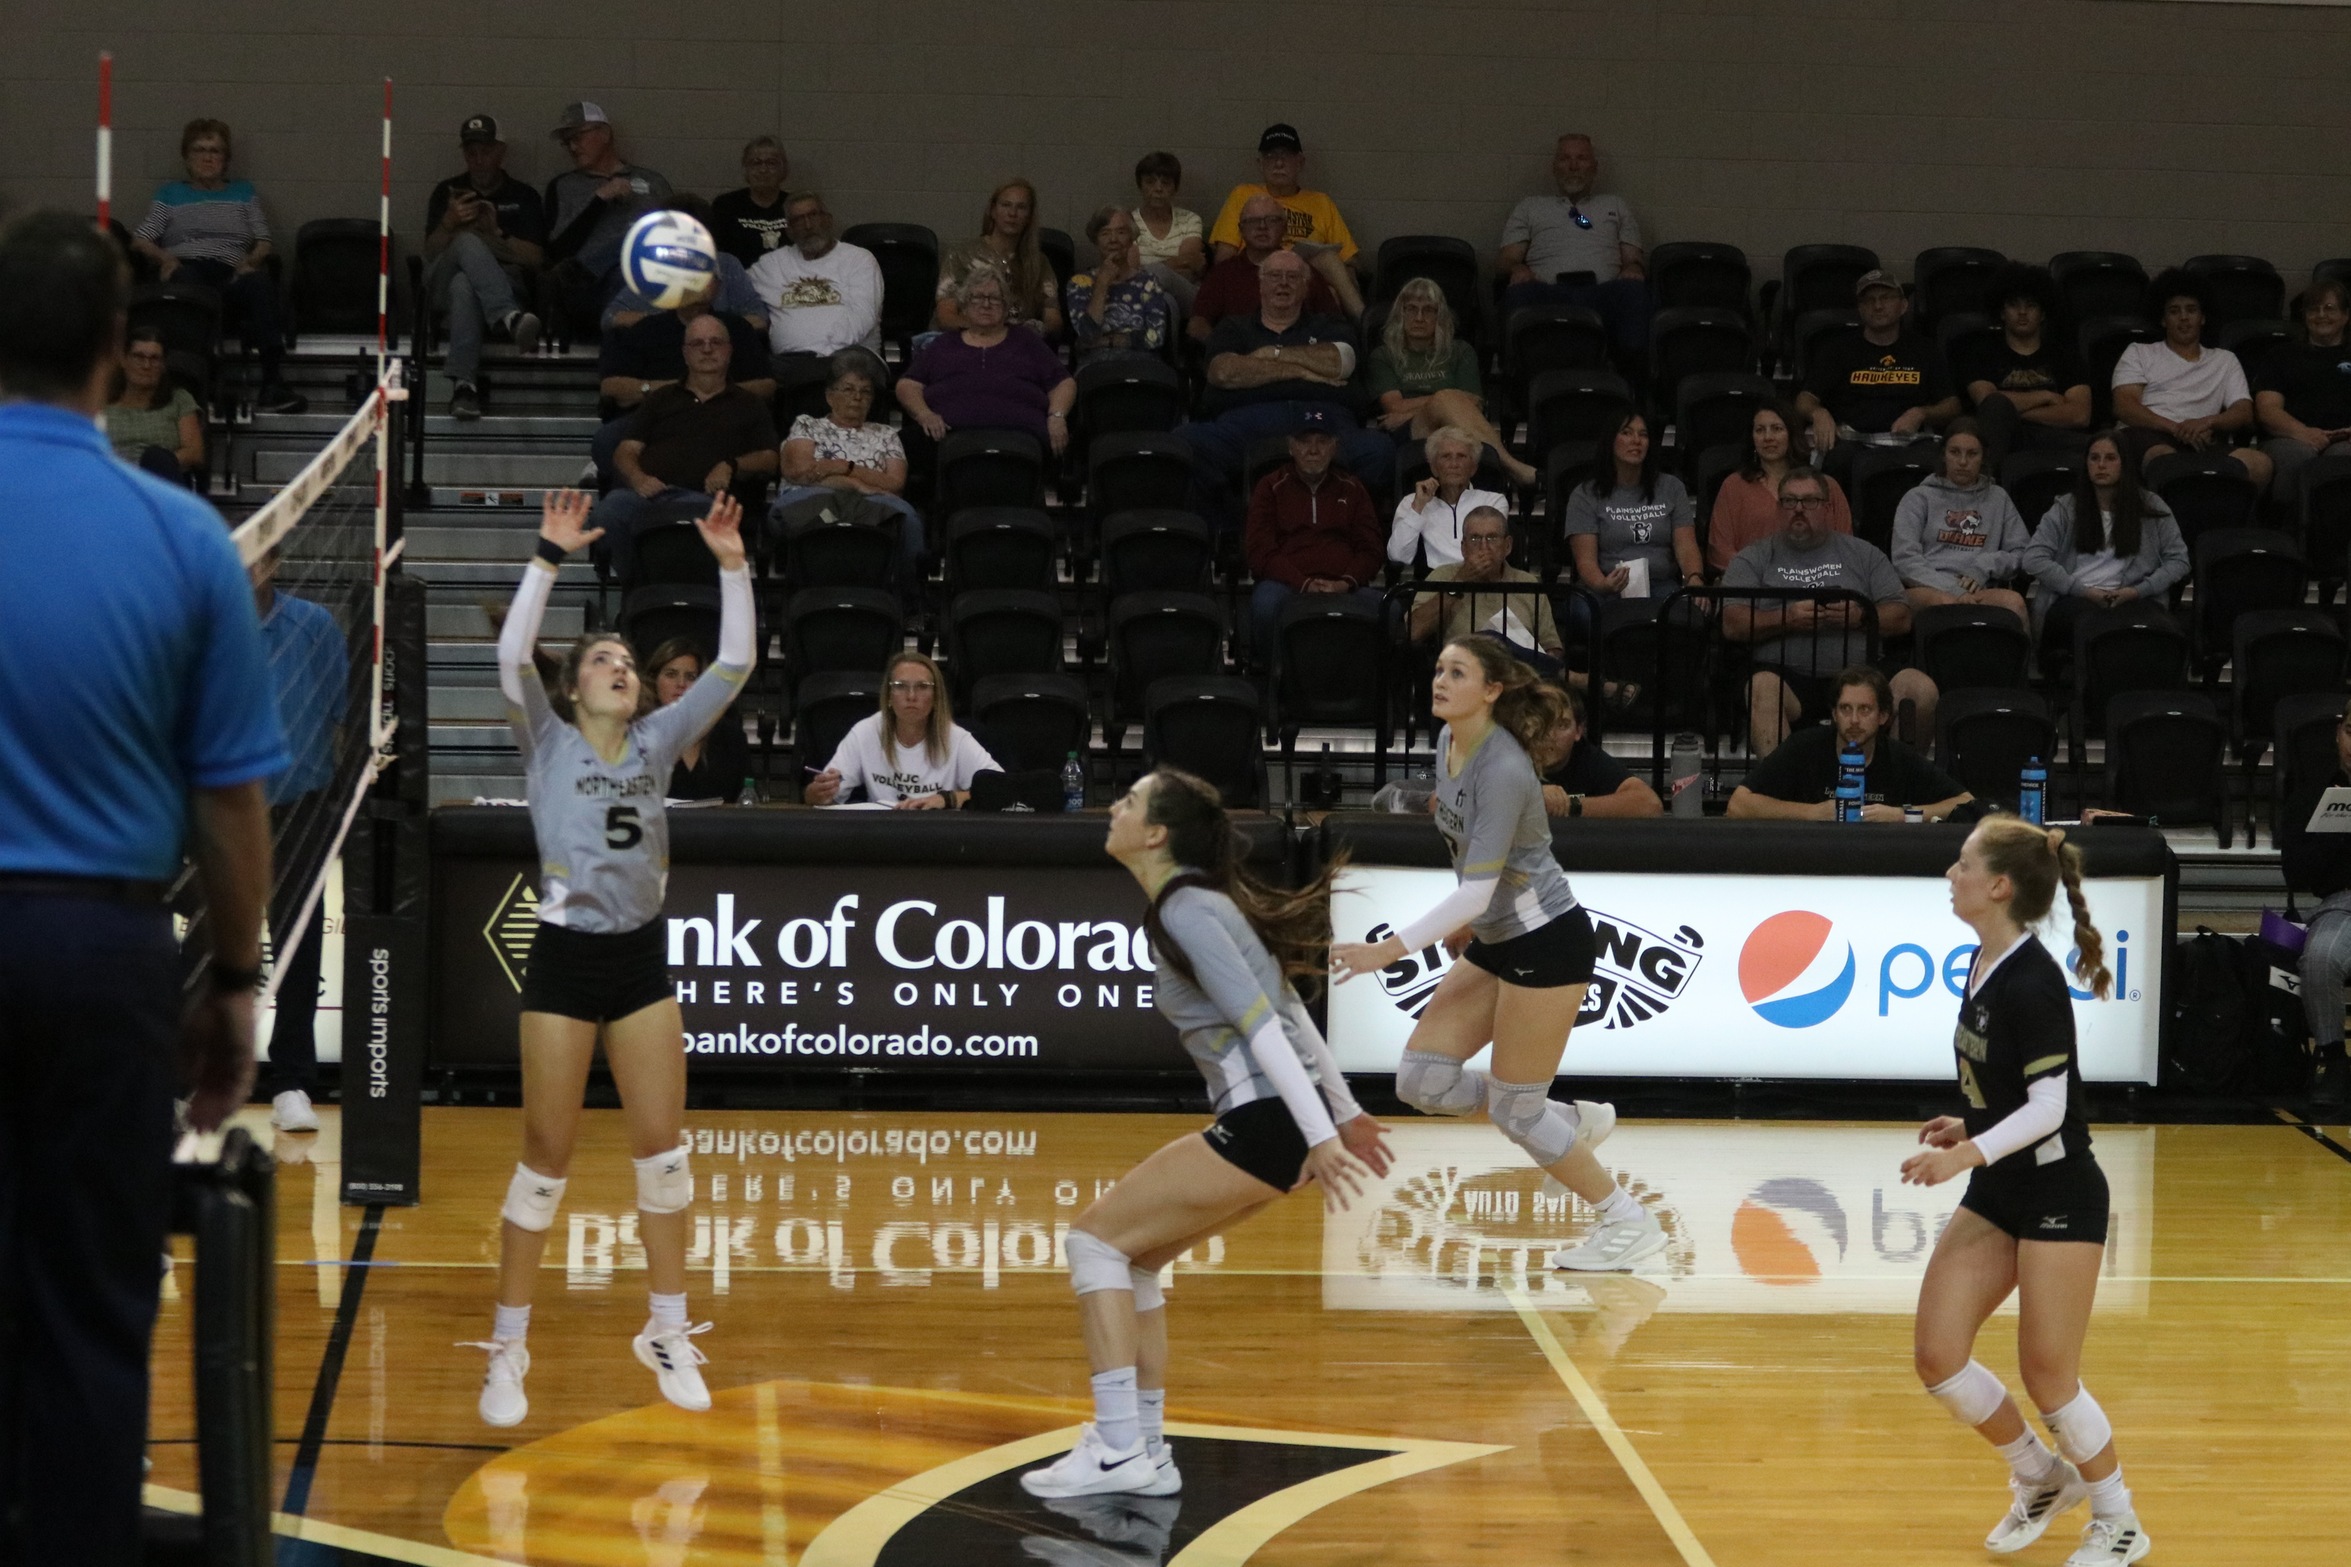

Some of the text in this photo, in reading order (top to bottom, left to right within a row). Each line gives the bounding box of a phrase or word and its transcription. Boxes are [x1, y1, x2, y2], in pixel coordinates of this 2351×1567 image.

[1852, 372, 1919, 383] HAWKEYES
[1605, 503, 1667, 515] PLAINSWOMEN
[1610, 510, 1666, 522] VOLLEYBALL
[1777, 562, 1842, 576] PLAINSWOMEN
[1782, 570, 1841, 583] VOLLEYBALL
[872, 773, 943, 794] VOLLEYBALL
[894, 772, 919, 783] NJC
[606, 806, 644, 850] 5
[667, 893, 1157, 972] nk of Colora
[670, 980, 1154, 1008] HERE'S ONLY ONE
[367, 947, 391, 1099] sports imports
